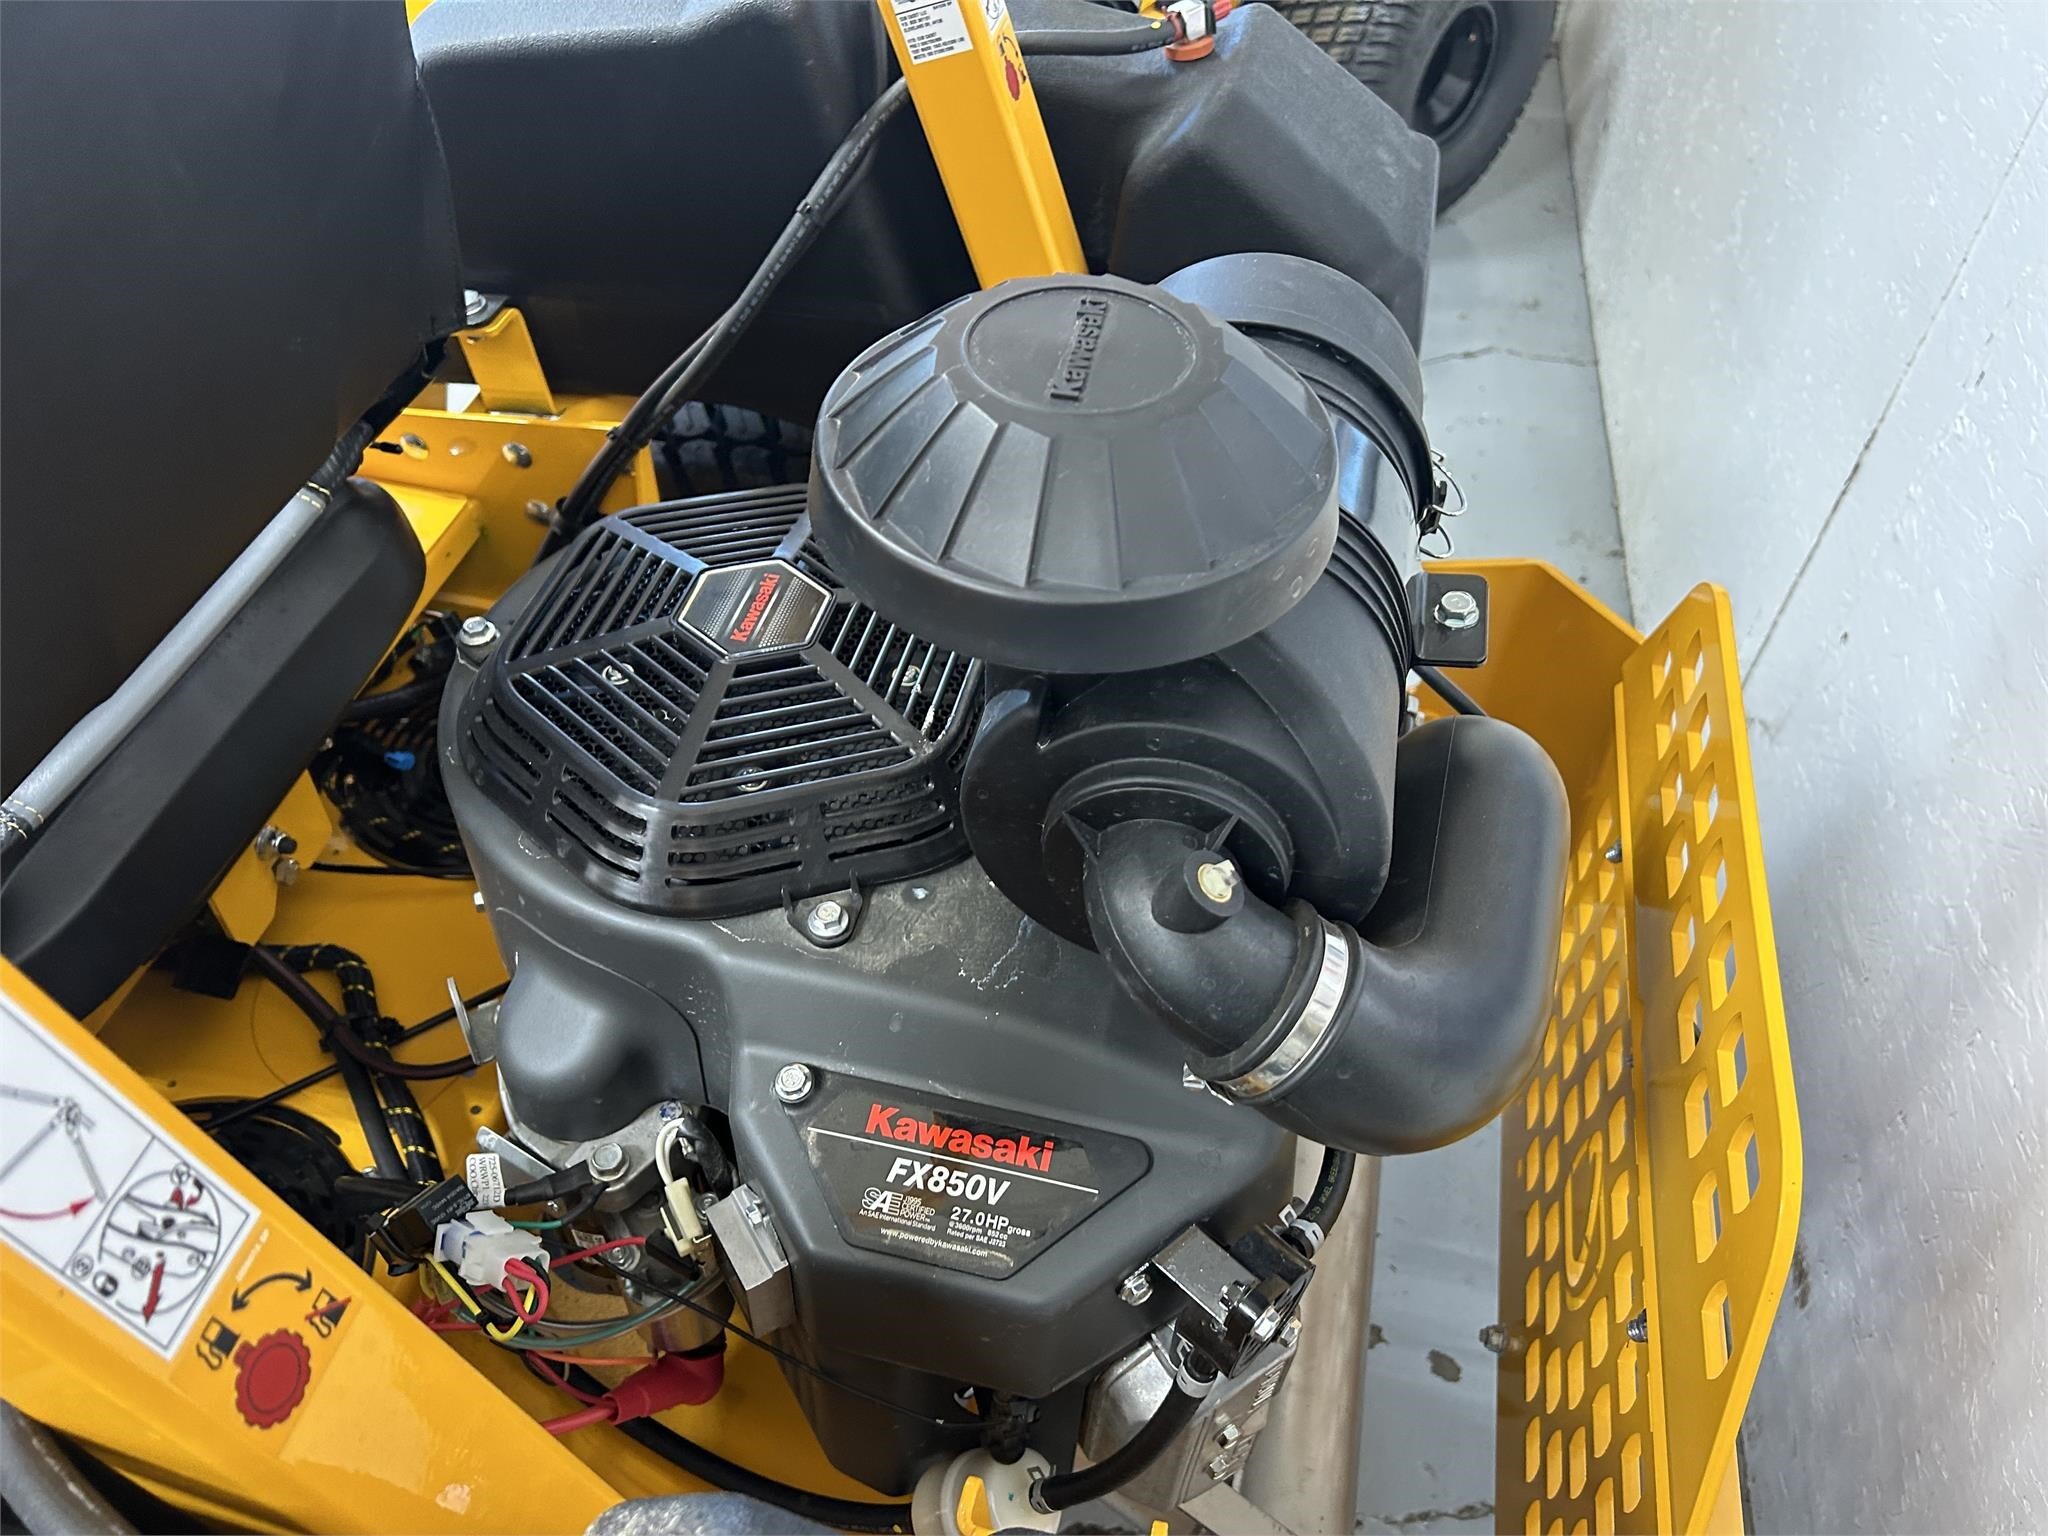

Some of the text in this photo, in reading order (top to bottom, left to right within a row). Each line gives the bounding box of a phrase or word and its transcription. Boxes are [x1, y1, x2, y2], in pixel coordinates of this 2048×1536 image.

[1050, 298, 1108, 401] Kawasaki
[729, 572, 782, 642] Kawasaki
[864, 1103, 1055, 1172] Kawasaki
[886, 1157, 1011, 1206] FX850V
[861, 1186, 904, 1216] SAE
[901, 1202, 936, 1216] CERTIFIED
[858, 1208, 936, 1232] An SAE International Standard
[1007, 1225, 1031, 1237] gross
[880, 1227, 988, 1257] www.poweredbykawasaki.com
[946, 1227, 965, 1238] Rated
[964, 1232, 975, 1241] per
[975, 1234, 988, 1244] SAE
